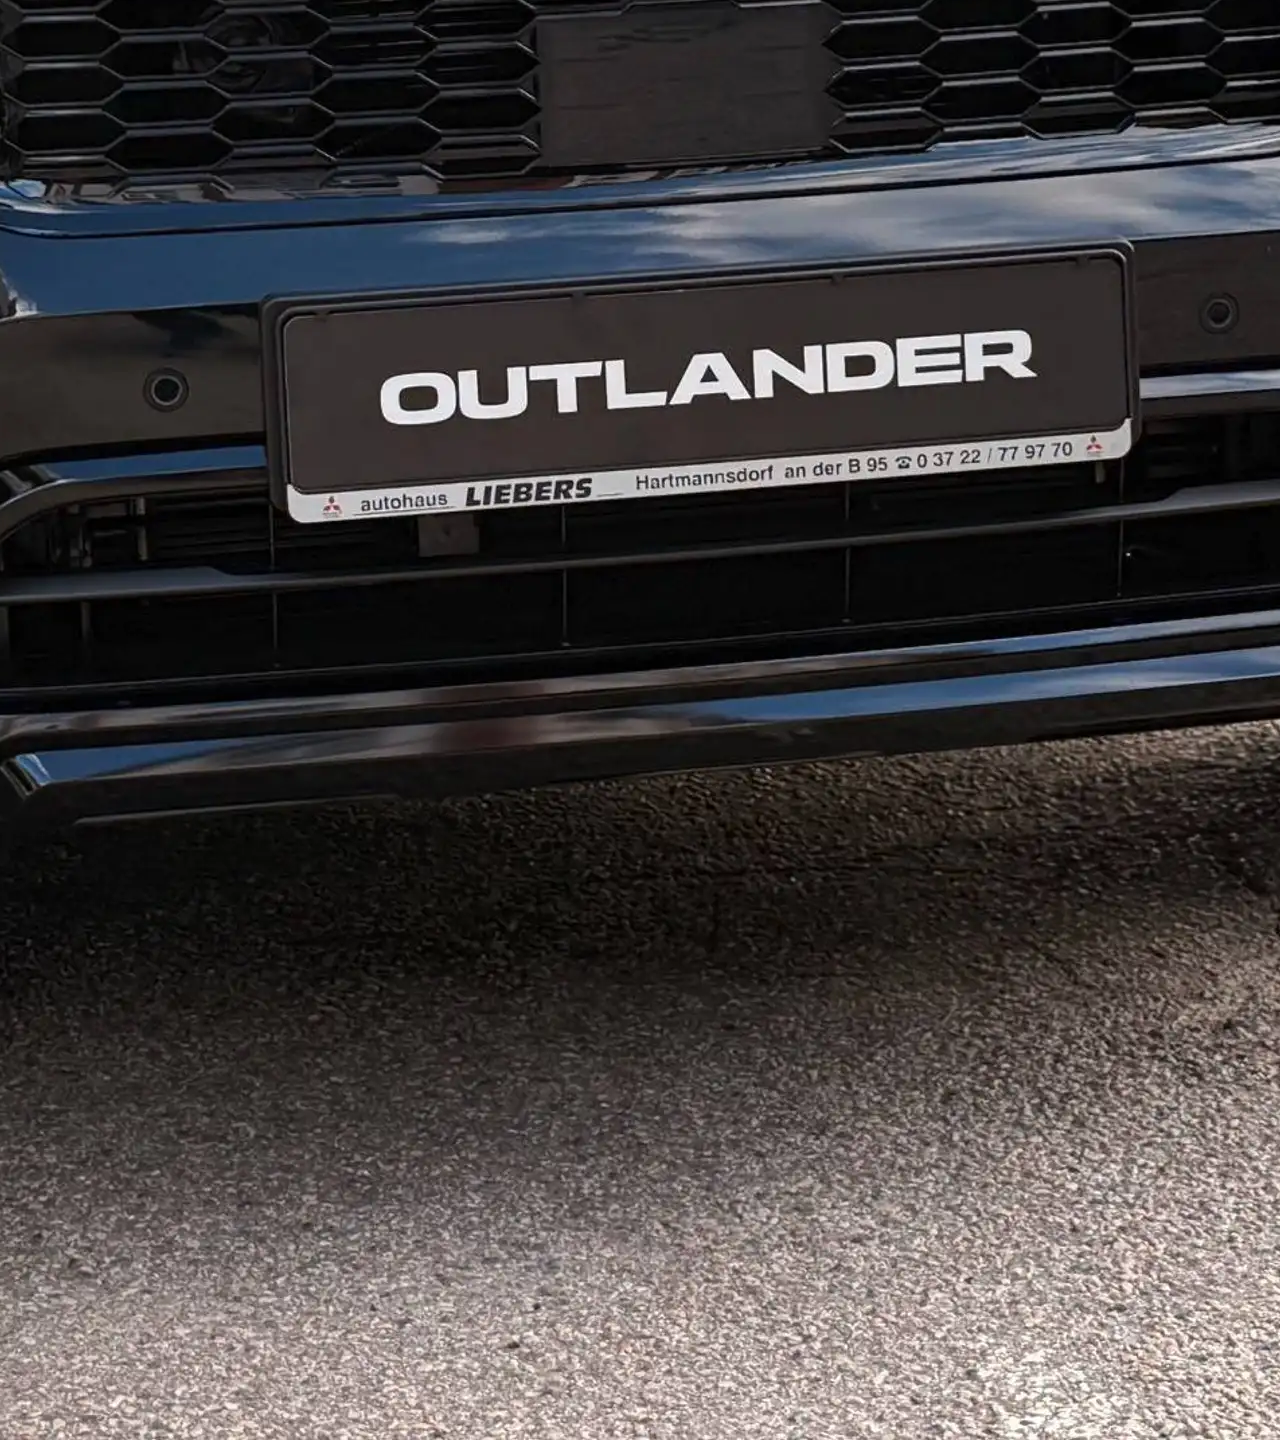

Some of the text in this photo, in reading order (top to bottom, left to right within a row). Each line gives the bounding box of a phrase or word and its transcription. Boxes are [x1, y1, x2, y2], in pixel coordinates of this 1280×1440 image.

[379, 329, 1038, 425] OUTLANDER
[360, 491, 448, 512] autohaus
[465, 477, 593, 508] LIEBERS
[635, 465, 774, 491] Hartmannsdorf
[784, 465, 807, 479] an
[812, 460, 842, 478] der
[848, 458, 861, 474] B
[867, 456, 888, 472] 95
[916, 453, 928, 469] 0
[932, 451, 954, 468] 37
[959, 449, 982, 465] 22
[997, 446, 1020, 462] 77
[1024, 444, 1046, 460] 97
[1051, 441, 1073, 458] 70
